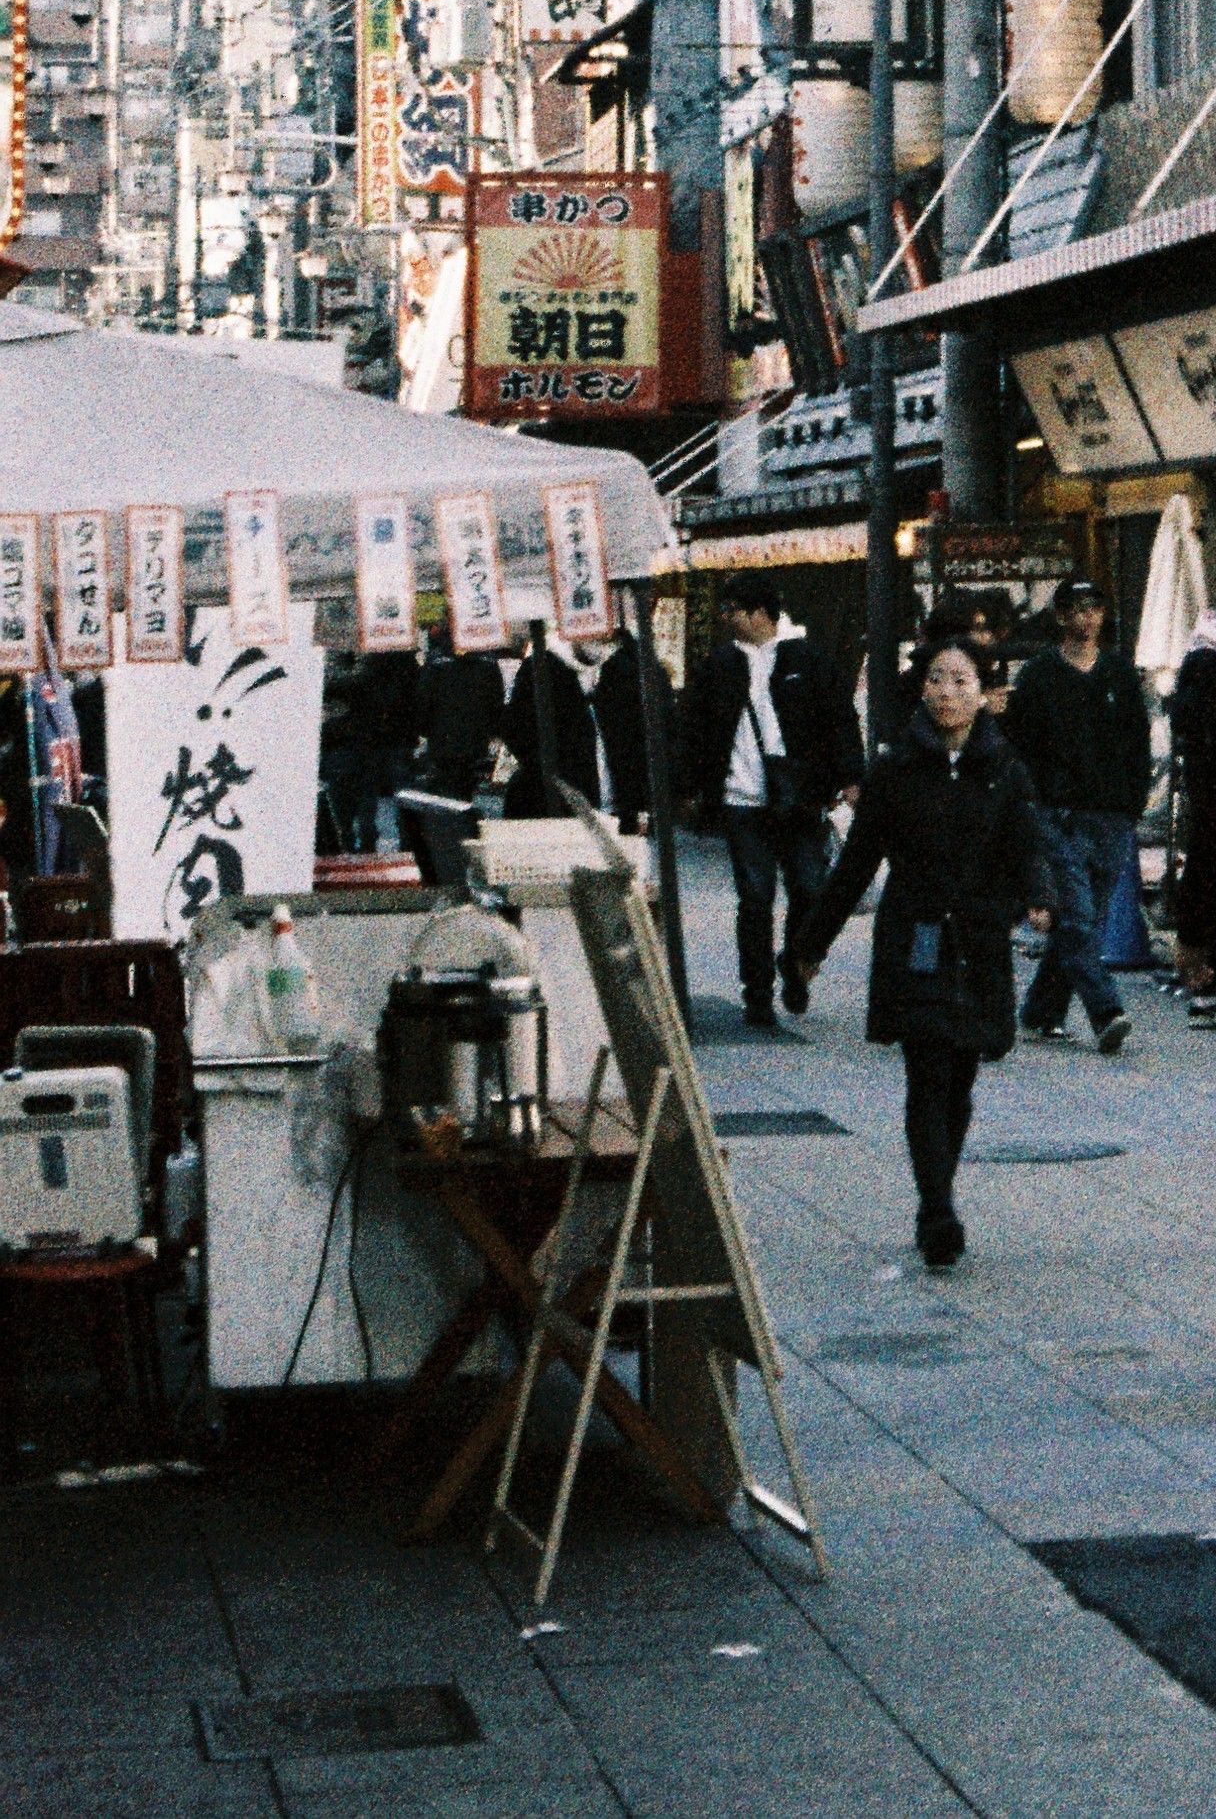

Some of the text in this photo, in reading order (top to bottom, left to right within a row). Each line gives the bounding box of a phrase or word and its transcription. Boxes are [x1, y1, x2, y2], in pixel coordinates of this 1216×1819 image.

[511, 189, 632, 225] 串かつ
[507, 306, 629, 362] 朝日
[499, 367, 642, 403] ホルモン
